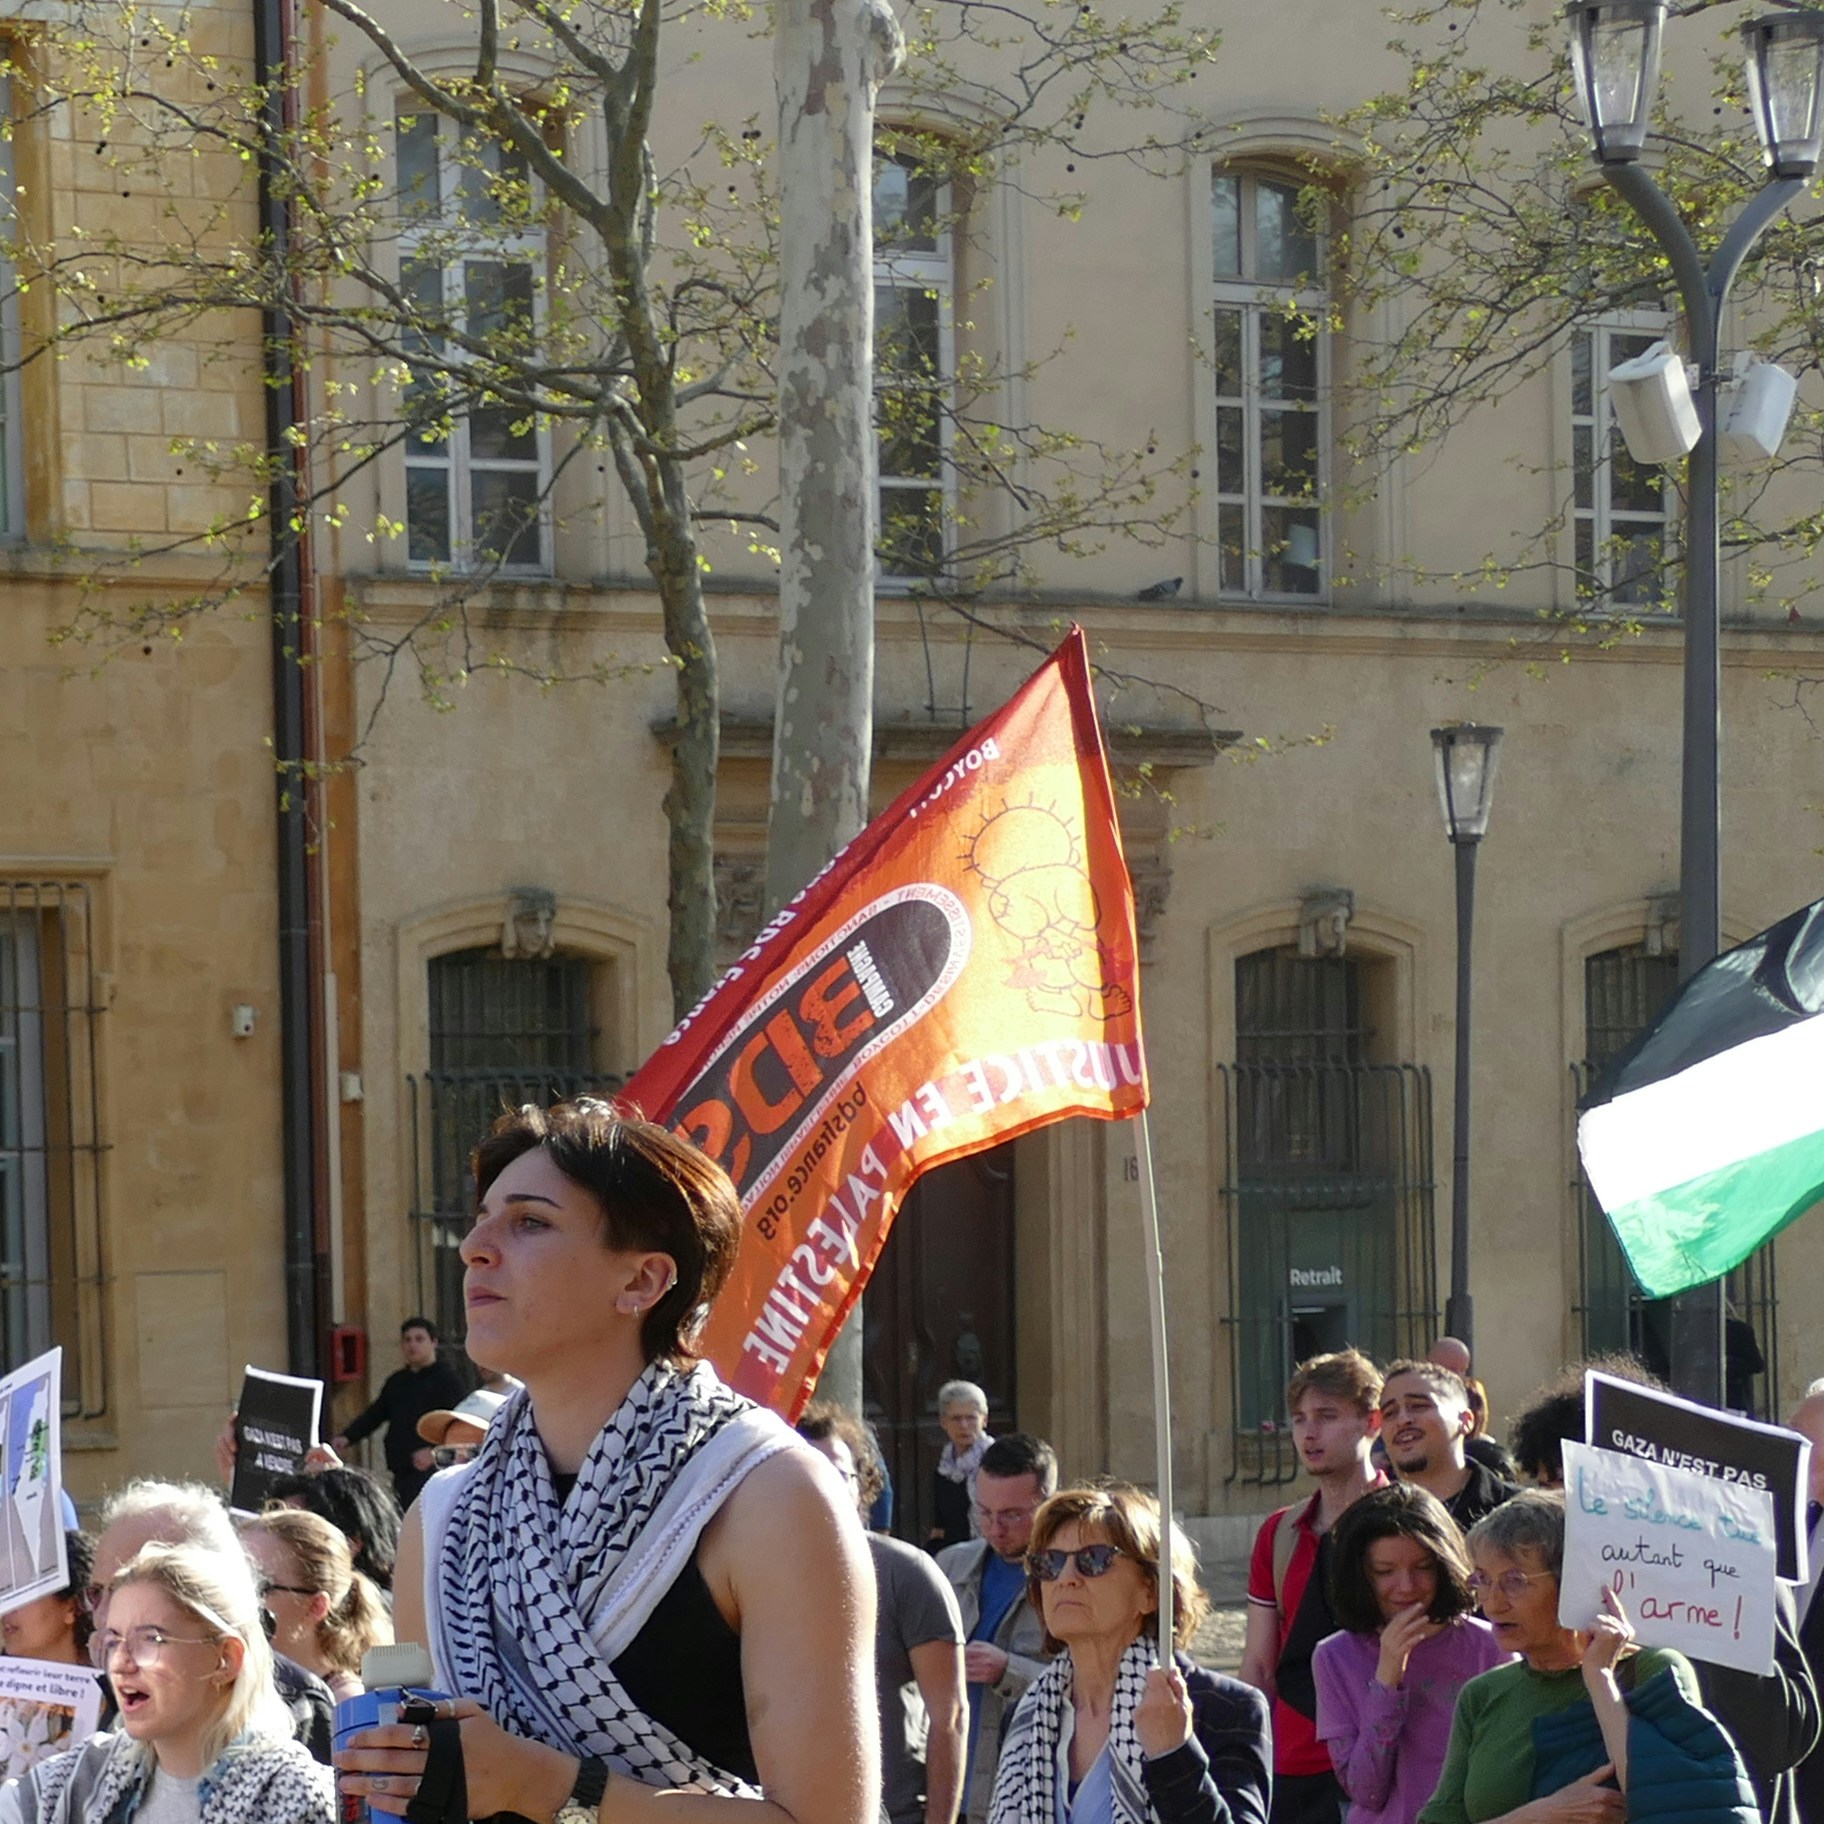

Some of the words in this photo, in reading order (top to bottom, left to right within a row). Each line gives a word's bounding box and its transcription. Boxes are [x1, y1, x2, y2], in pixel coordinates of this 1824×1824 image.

[1289, 1264, 1343, 1287] Retrait
[1611, 1429, 1657, 1460] GAZA
[1662, 1448, 1718, 1477] N'EST
[1723, 1465, 1767, 1490] PAS
[1578, 1465, 1609, 1516] Le
[1624, 1487, 1703, 1531] silence
[1718, 1513, 1762, 1546] tue
[1602, 1535, 1685, 1569] autant
[1704, 1558, 1741, 1589] que
[1640, 1597, 1723, 1627] arme
[6, 1678, 34, 1692] digne
[36, 1682, 47, 1693] et
[49, 1682, 78, 1699] libre
[64, 1672, 92, 1685] terre
